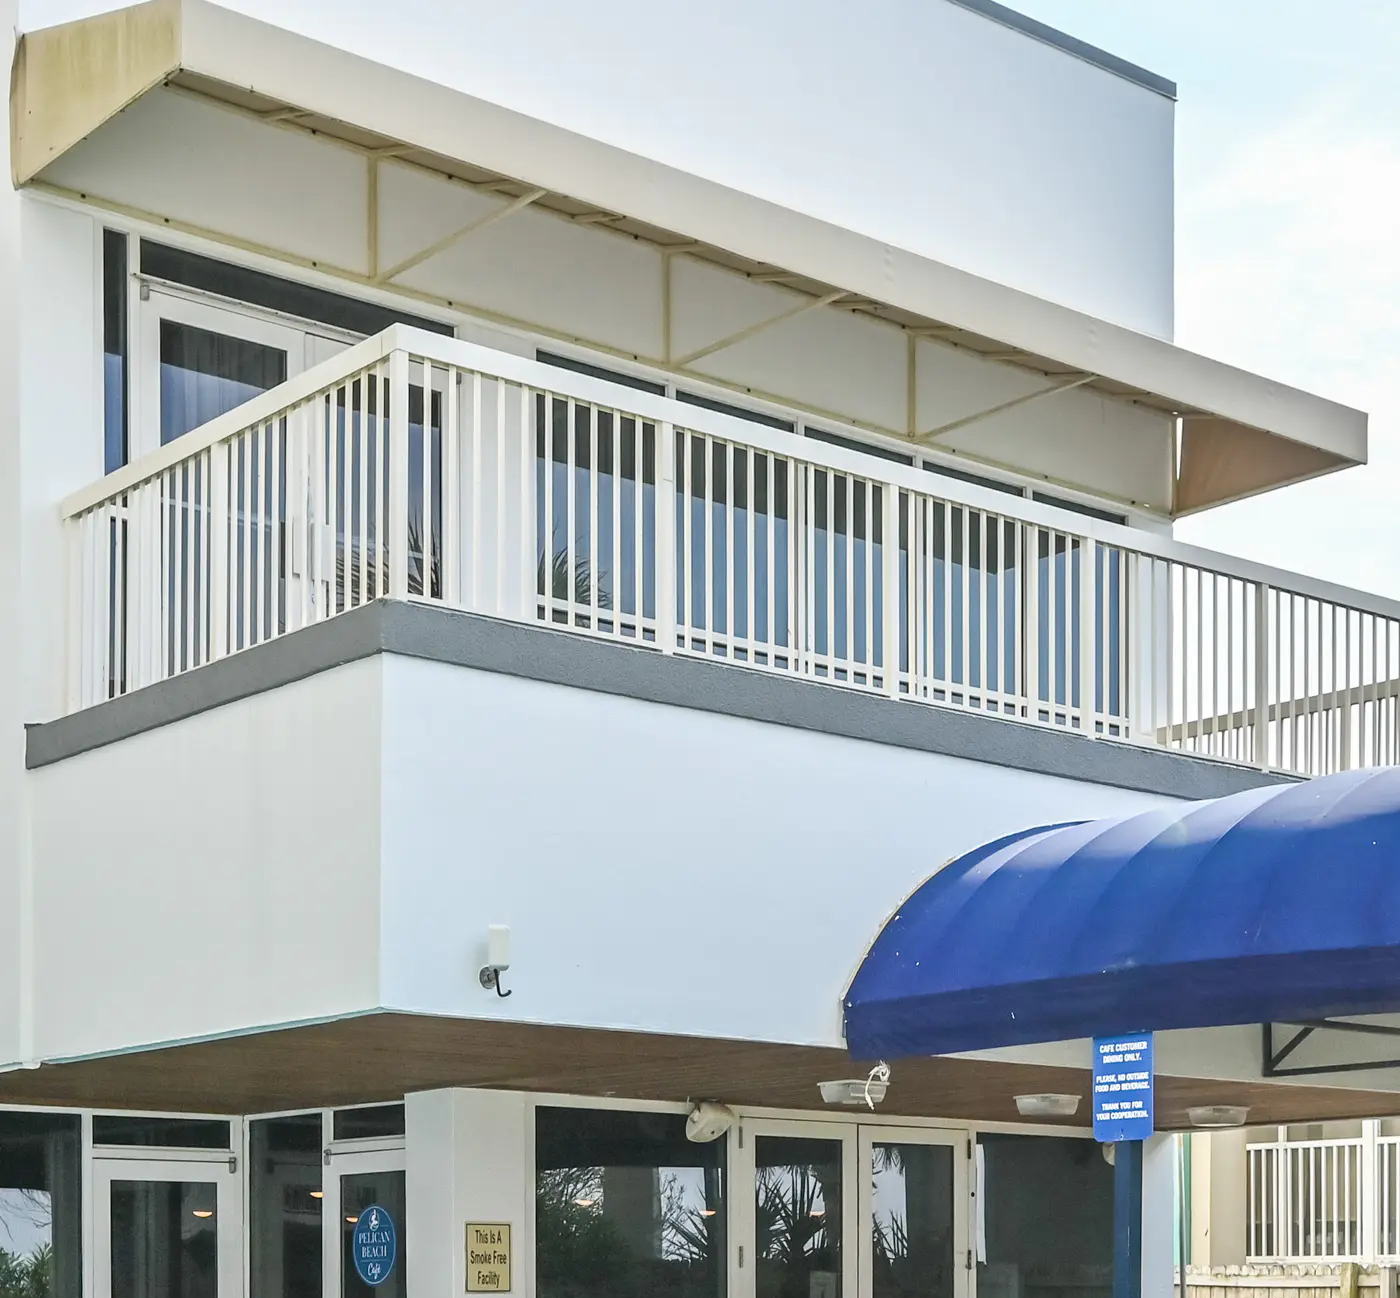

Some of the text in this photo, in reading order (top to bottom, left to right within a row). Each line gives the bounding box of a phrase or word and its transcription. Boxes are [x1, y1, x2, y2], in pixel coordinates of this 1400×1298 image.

[1099, 1041, 1148, 1053] CAFE CUSTOMER
[1102, 1052, 1142, 1064] DINING ONLY.
[1096, 1071, 1149, 1084] PLEASE, NO OUTSIDE
[1095, 1081, 1150, 1093] FOOD AND BEVERAGE.
[1101, 1101, 1143, 1111] THANK YOU FOR
[1096, 1110, 1149, 1121] YOUR COOPERATION.
[358, 1231, 390, 1244] PELICAN
[475, 1229, 502, 1244] This Is A
[361, 1245, 387, 1258] BEACH
[470, 1249, 507, 1265] Smoke Free
[477, 1270, 500, 1289] Facility
